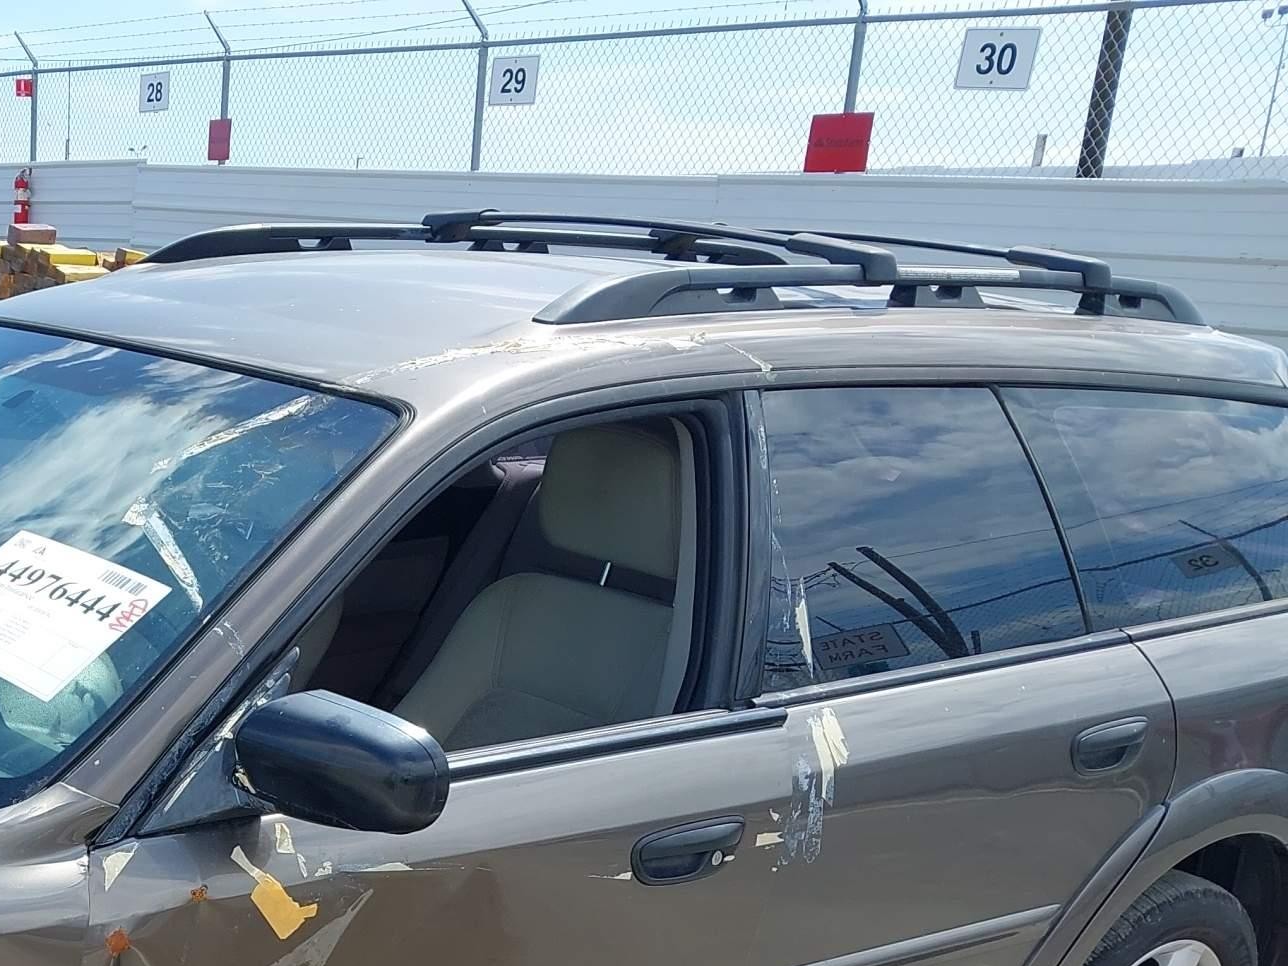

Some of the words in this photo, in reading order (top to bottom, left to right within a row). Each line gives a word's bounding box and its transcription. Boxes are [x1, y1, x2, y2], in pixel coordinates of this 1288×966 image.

[975, 42, 1018, 76] 30
[146, 81, 163, 103] 28
[500, 67, 527, 94] 29
